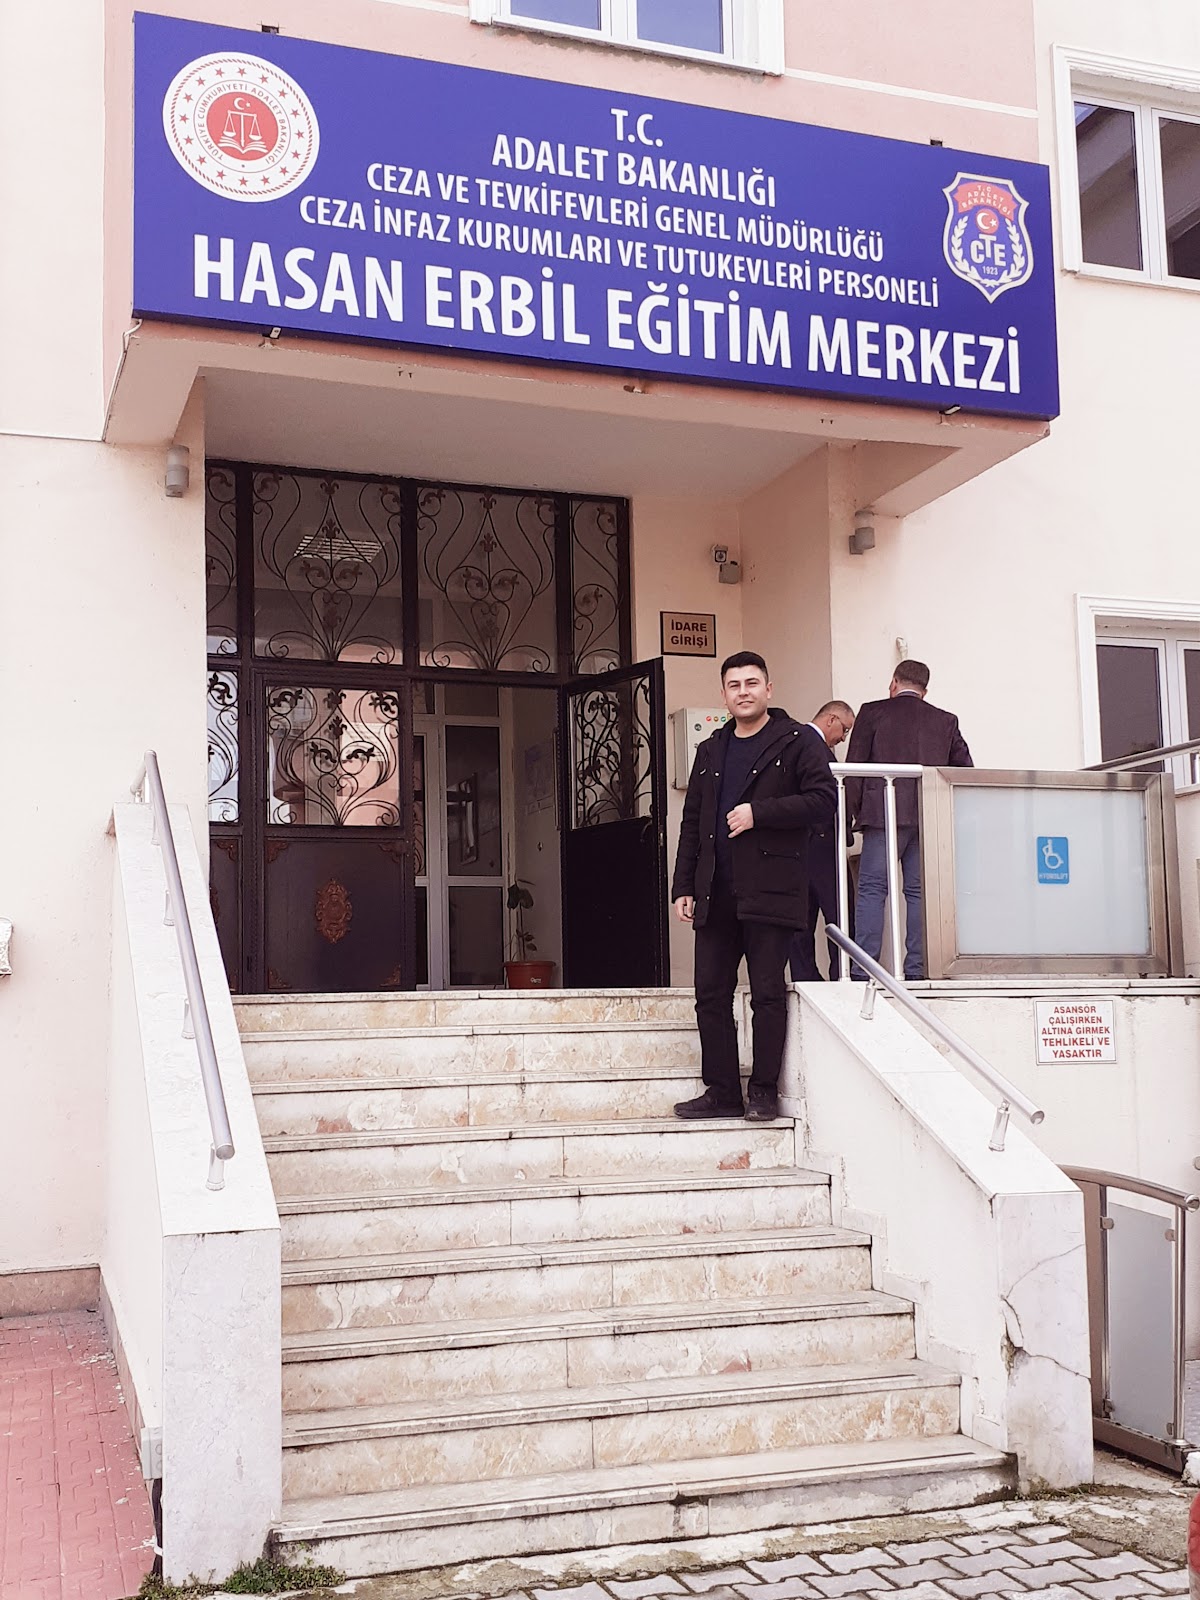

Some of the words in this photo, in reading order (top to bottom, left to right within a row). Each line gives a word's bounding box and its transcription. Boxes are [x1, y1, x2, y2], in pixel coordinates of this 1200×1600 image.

[197, 83, 248, 119] CUMHURİYETİ
[251, 87, 282, 115] ADALET
[610, 108, 664, 147] T.C.
[197, 123, 223, 161] TÜRKİYE
[265, 119, 287, 165] BAKANLIĞI
[491, 134, 609, 182] ADALET
[617, 152, 776, 208] BAKANLIĞI
[967, 191, 1004, 203] ADALET
[367, 162, 432, 198] CEZA
[437, 172, 470, 204] VE
[475, 178, 648, 229] TEVKİFEVLERİ
[655, 205, 731, 241] GENEL
[737, 214, 883, 262] MÜDÜRLÜĞÜ
[299, 195, 367, 231] CEZA
[374, 198, 451, 243] İNFAZ
[458, 217, 611, 265] KURUMLARI
[617, 239, 648, 269] VE
[653, 244, 812, 292] TUTUKEVLERİ
[819, 267, 939, 308] PERSONELİ
[970, 233, 1007, 267] CTE
[982, 266, 999, 276] 1923
[194, 234, 404, 322] HASAN
[425, 264, 591, 345] ERBİL
[607, 281, 792, 369] EĞİTİM
[808, 314, 1020, 394] MERKEZİ
[671, 619, 707, 631] İDARE
[670, 633, 708, 648] GİRİŞİ
[1048, 1016, 1103, 1026] ÇALIŞIRKEN
[1053, 1003, 1097, 1014] ASANSÖR
[1041, 1027, 1073, 1035] ALTINA
[1075, 1025, 1111, 1035] GİRMEK
[1042, 1035, 1095, 1047] TEHLİKELİ
[1097, 1037, 1110, 1046] VE
[1052, 1049, 1103, 1059] YASAKTIR
